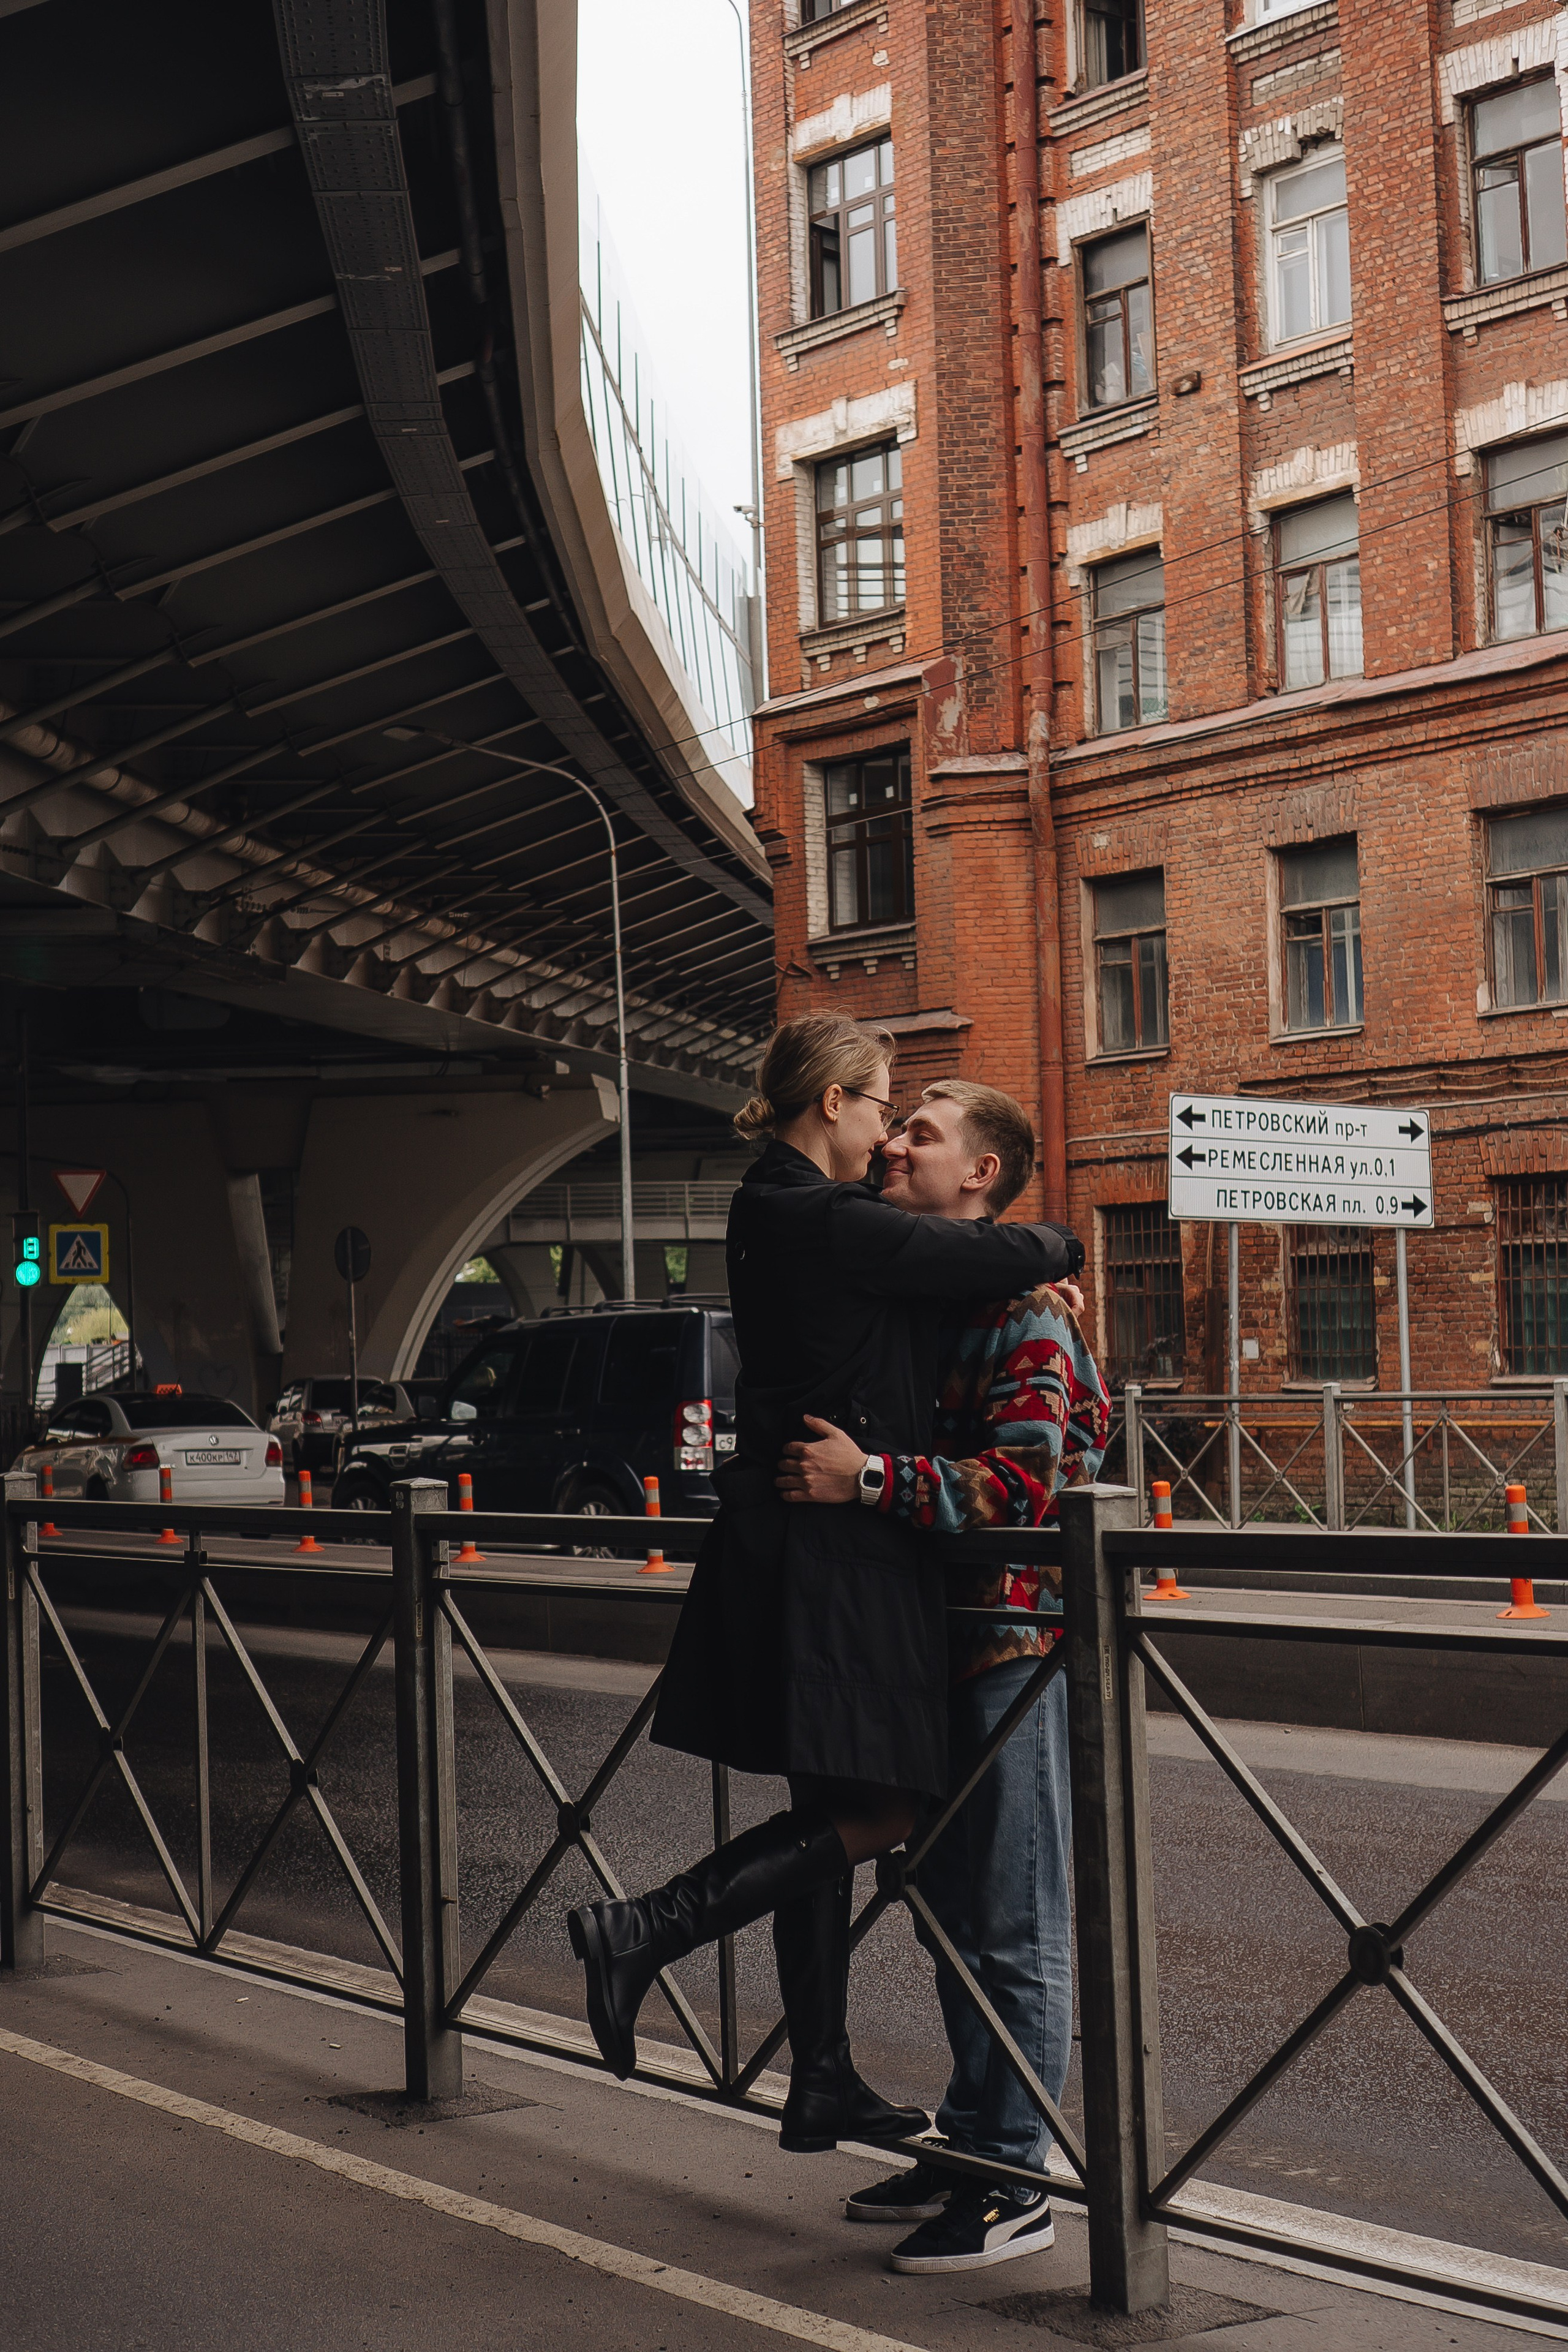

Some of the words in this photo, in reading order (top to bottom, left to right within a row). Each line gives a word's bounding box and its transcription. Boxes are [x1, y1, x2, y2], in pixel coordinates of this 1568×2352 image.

[1212, 1109, 1329, 1136] ПЕТРОВСКИЙ
[1335, 1123, 1367, 1141] пр-т
[1208, 1148, 1344, 1174] РЕМЕСЛЕННАЯ
[1216, 1189, 1336, 1212] ПЕТРОВСКАЯ
[1343, 1199, 1366, 1213] пл.
[1376, 1196, 1398, 1216] 0,9
